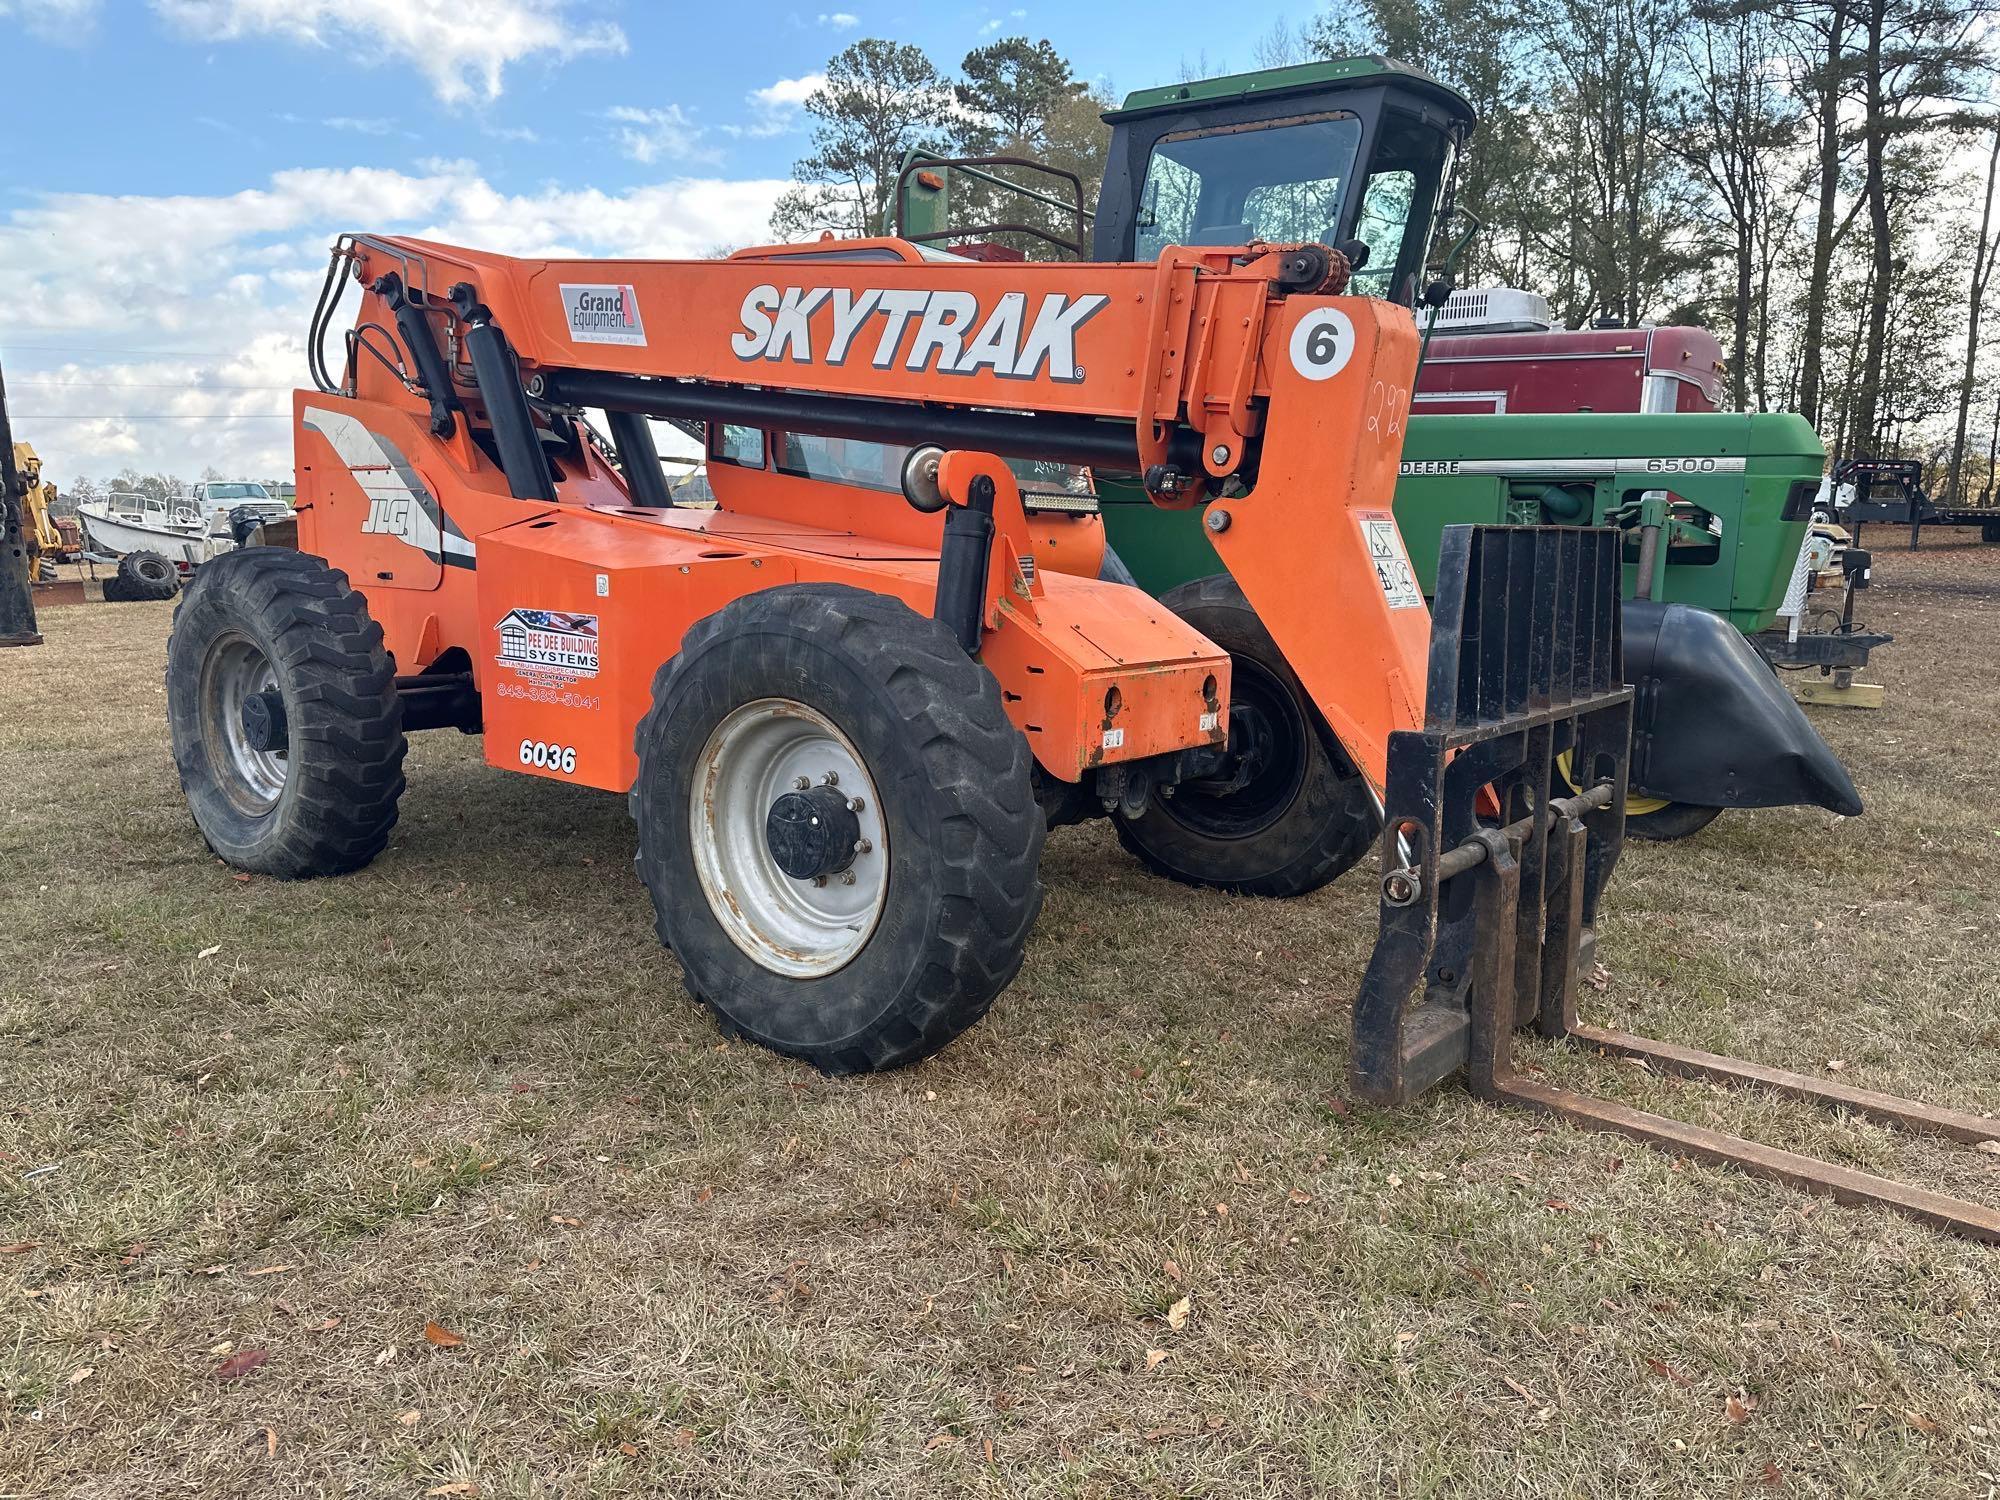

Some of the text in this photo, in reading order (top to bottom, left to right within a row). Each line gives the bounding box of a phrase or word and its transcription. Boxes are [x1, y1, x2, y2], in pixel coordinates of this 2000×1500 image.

[580, 291, 624, 312] Grand
[573, 306, 626, 331] Equipment
[1305, 322, 1339, 366] 6
[1367, 380, 1407, 446] 292
[1400, 461, 1460, 475] DEERE
[1646, 458, 1717, 473] 6500
[360, 498, 408, 536] JLG
[528, 632, 598, 656] PEE DEE BUILDING
[499, 660, 595, 678] METAL BUILDING SPECIALISTS
[529, 649, 598, 667] SYSTEMS
[540, 673, 577, 683] CONTRACTOR
[496, 682, 600, 711] 843-383-5041
[519, 738, 577, 775] 6036
